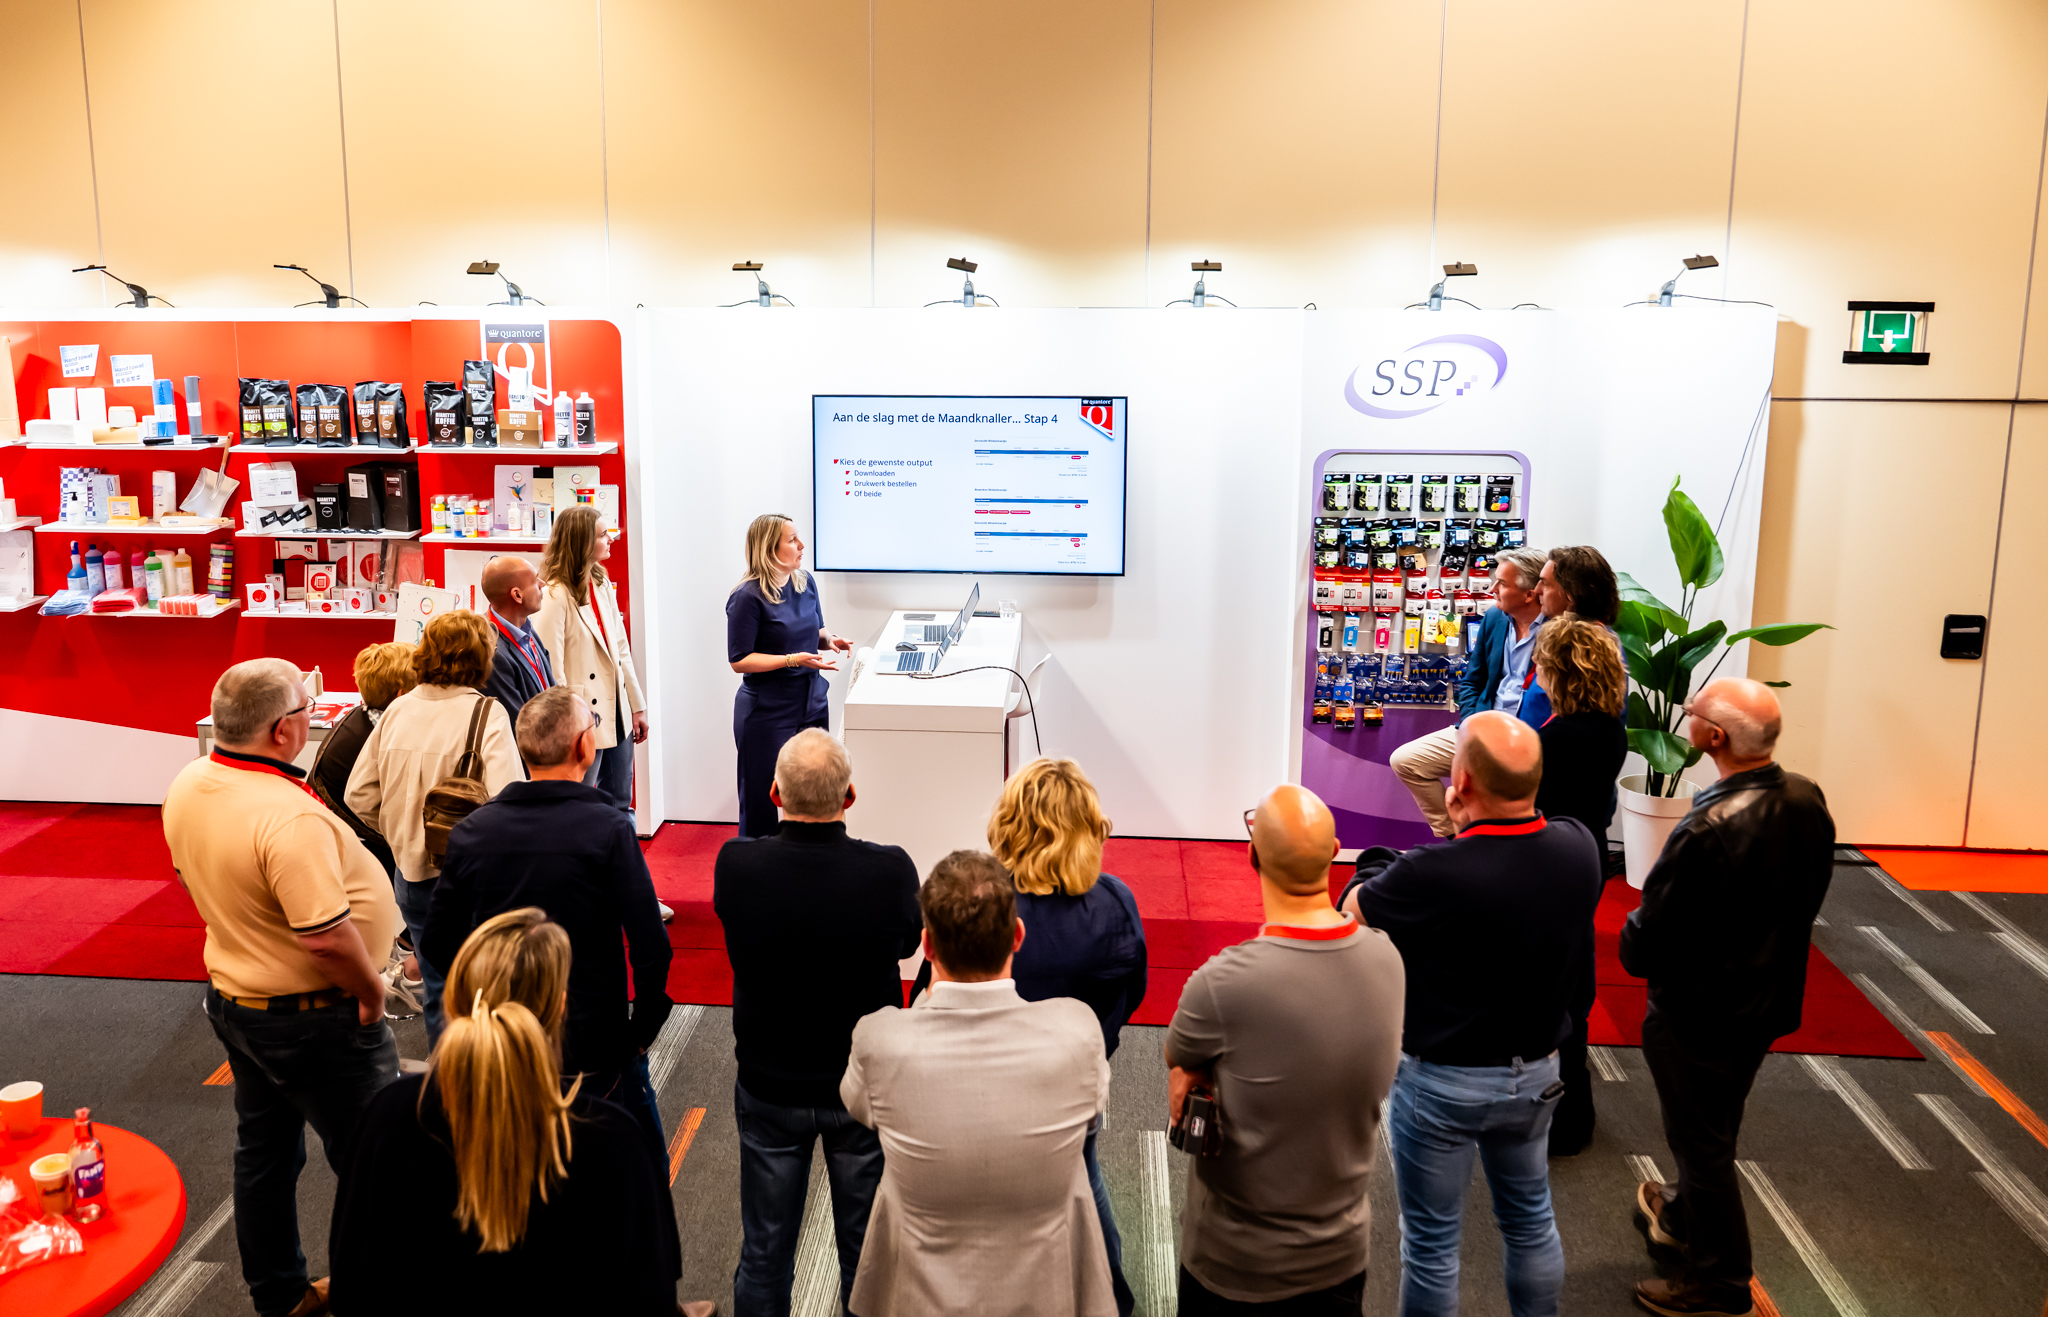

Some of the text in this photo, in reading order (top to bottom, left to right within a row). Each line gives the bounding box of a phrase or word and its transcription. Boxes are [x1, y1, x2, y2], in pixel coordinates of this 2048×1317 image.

[500, 330, 541, 339] quantore
[1371, 359, 1457, 397] SSP
[833, 412, 1058, 426] Aan de slag met de Maandknaller... Stap 4
[839, 458, 933, 468] Kies de gewenste output
[887, 480, 918, 488] bestellen
